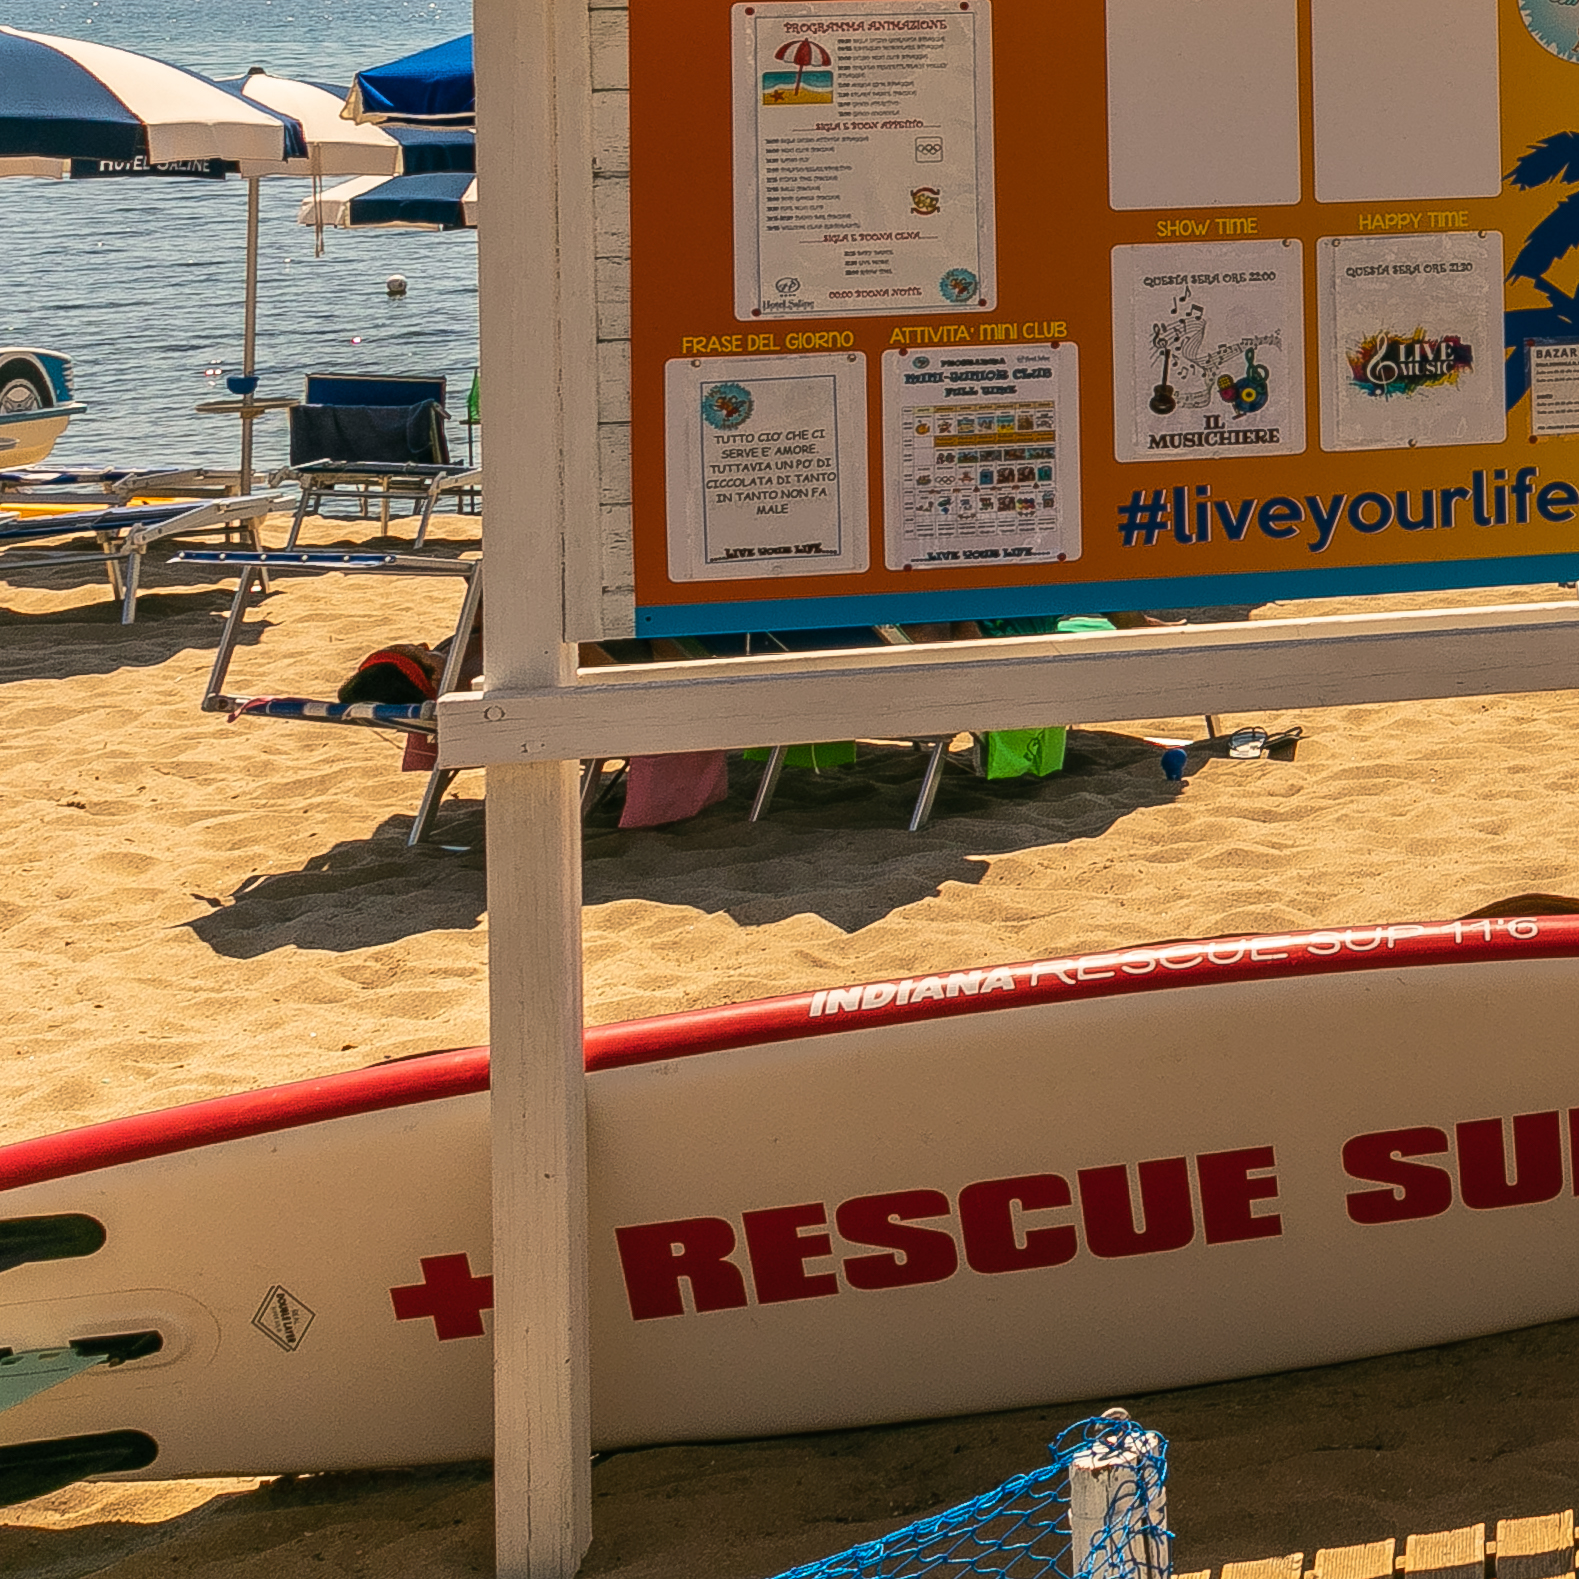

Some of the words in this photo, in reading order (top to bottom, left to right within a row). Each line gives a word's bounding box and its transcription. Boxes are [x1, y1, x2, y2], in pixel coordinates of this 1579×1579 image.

[1156, 219, 1209, 237] SHOW
[1215, 218, 1258, 235] TIME
[1358, 213, 1423, 231] HAPPY
[1427, 211, 1469, 228] TIME
[1346, 265, 1390, 278] QUESTA
[1392, 264, 1421, 276] SERA
[1423, 263, 1446, 274] ORE
[1143, 274, 1188, 287] QUESTA
[1191, 273, 1220, 286] SERA
[1223, 272, 1246, 283] ORE
[890, 325, 974, 344] ATTIVITA'
[979, 323, 1017, 341] MINI
[1022, 321, 1067, 338] CLUB
[682, 335, 742, 353] FRASE
[748, 334, 780, 351] DEL
[785, 331, 854, 349] GIORNO
[1399, 341, 1454, 361] LIVE
[1536, 348, 1578, 359] BAZAR
[1400, 361, 1454, 376] MUSIC
[1203, 414, 1225, 430] IL
[713, 433, 755, 445] TUTTO
[785, 430, 809, 441] CHE
[811, 428, 826, 439] CI
[1147, 428, 1280, 450] MUSICHIERE
[721, 447, 759, 459] SERVE
[709, 462, 772, 474] TUTTAVIA
[775, 460, 794, 471] UN
[817, 457, 831, 468] DI
[706, 476, 773, 489] CICCOLATA
[776, 475, 791, 485] DI
[794, 472, 836, 483] TANTO
[716, 493, 732, 503] IN
[736, 491, 778, 502] TANTO
[781, 488, 808, 499] NON
[811, 487, 827, 497] FA
[756, 503, 789, 515] MALE
[809, 966, 1016, 1018] INDIANA
[1030, 934, 1289, 986] RESCUE
[1307, 924, 1425, 956] SUP
[614, 1145, 1285, 1323] RESCUE
